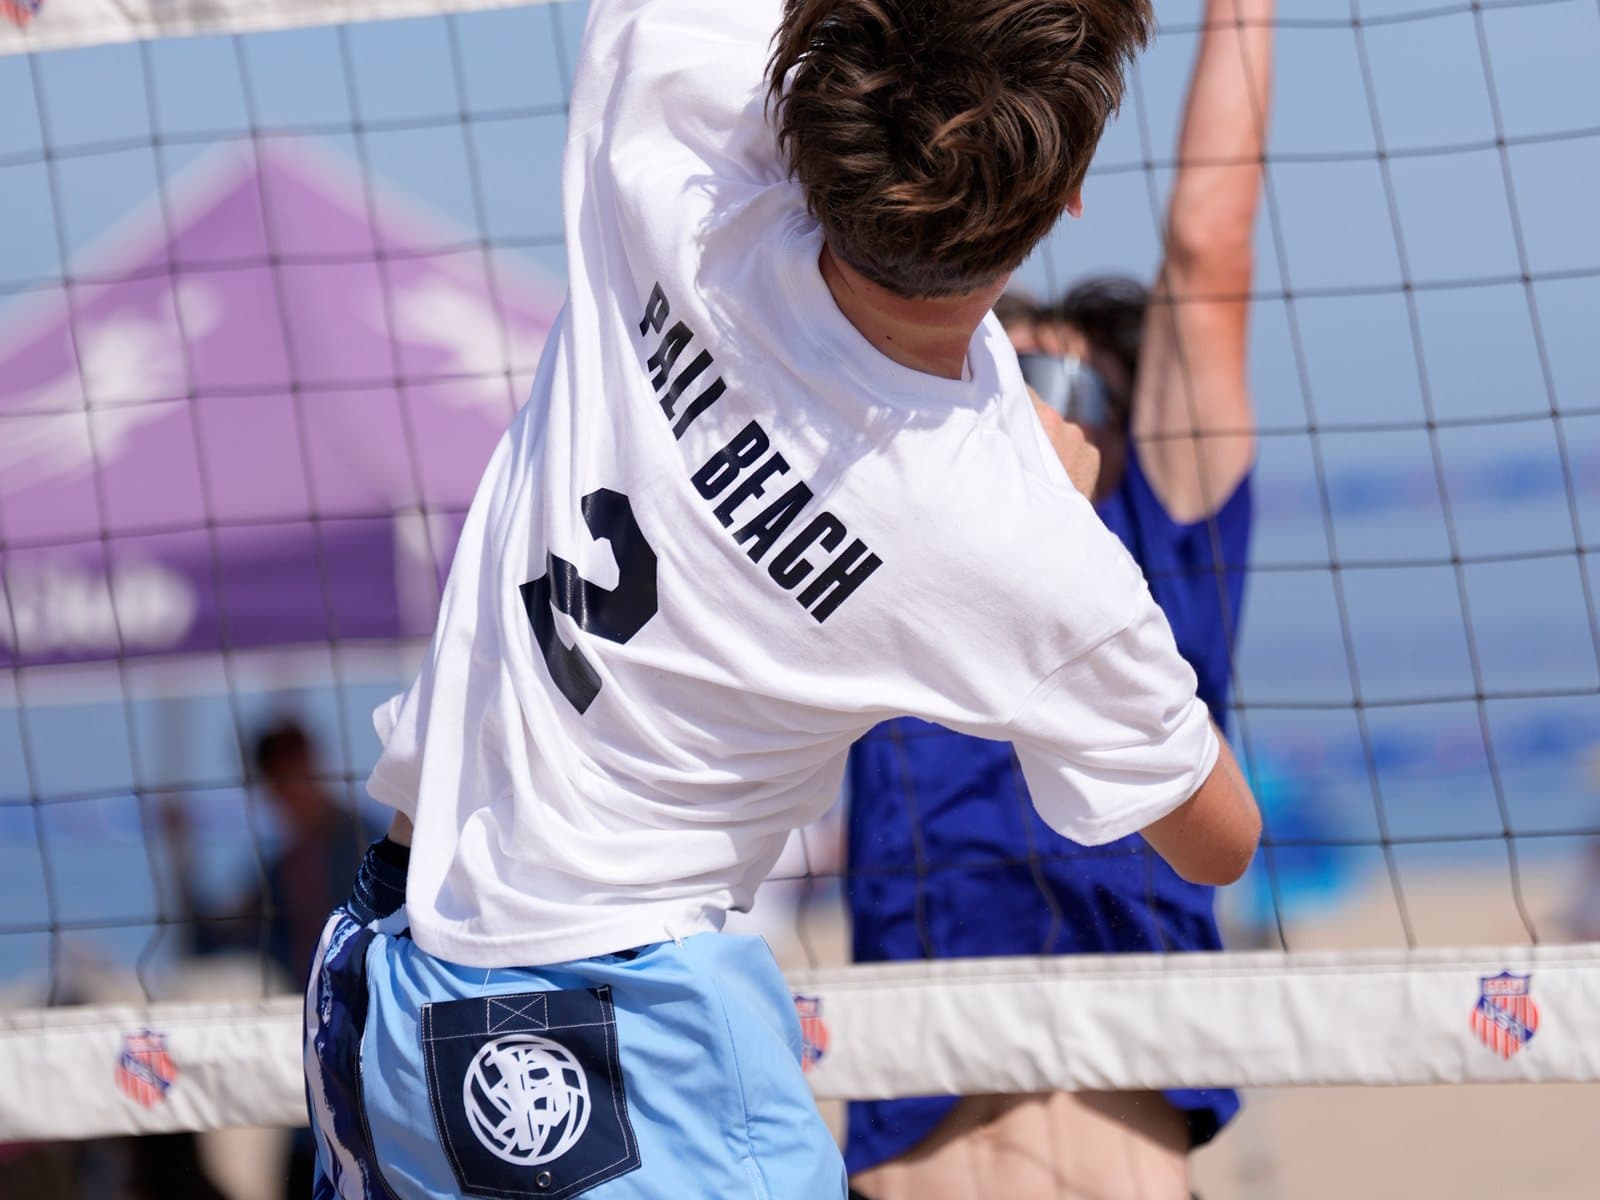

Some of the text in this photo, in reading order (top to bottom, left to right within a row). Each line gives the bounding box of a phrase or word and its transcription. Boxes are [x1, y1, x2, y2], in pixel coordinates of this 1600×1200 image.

[639, 281, 883, 624] PALI BEACH
[519, 487, 658, 716] 2
